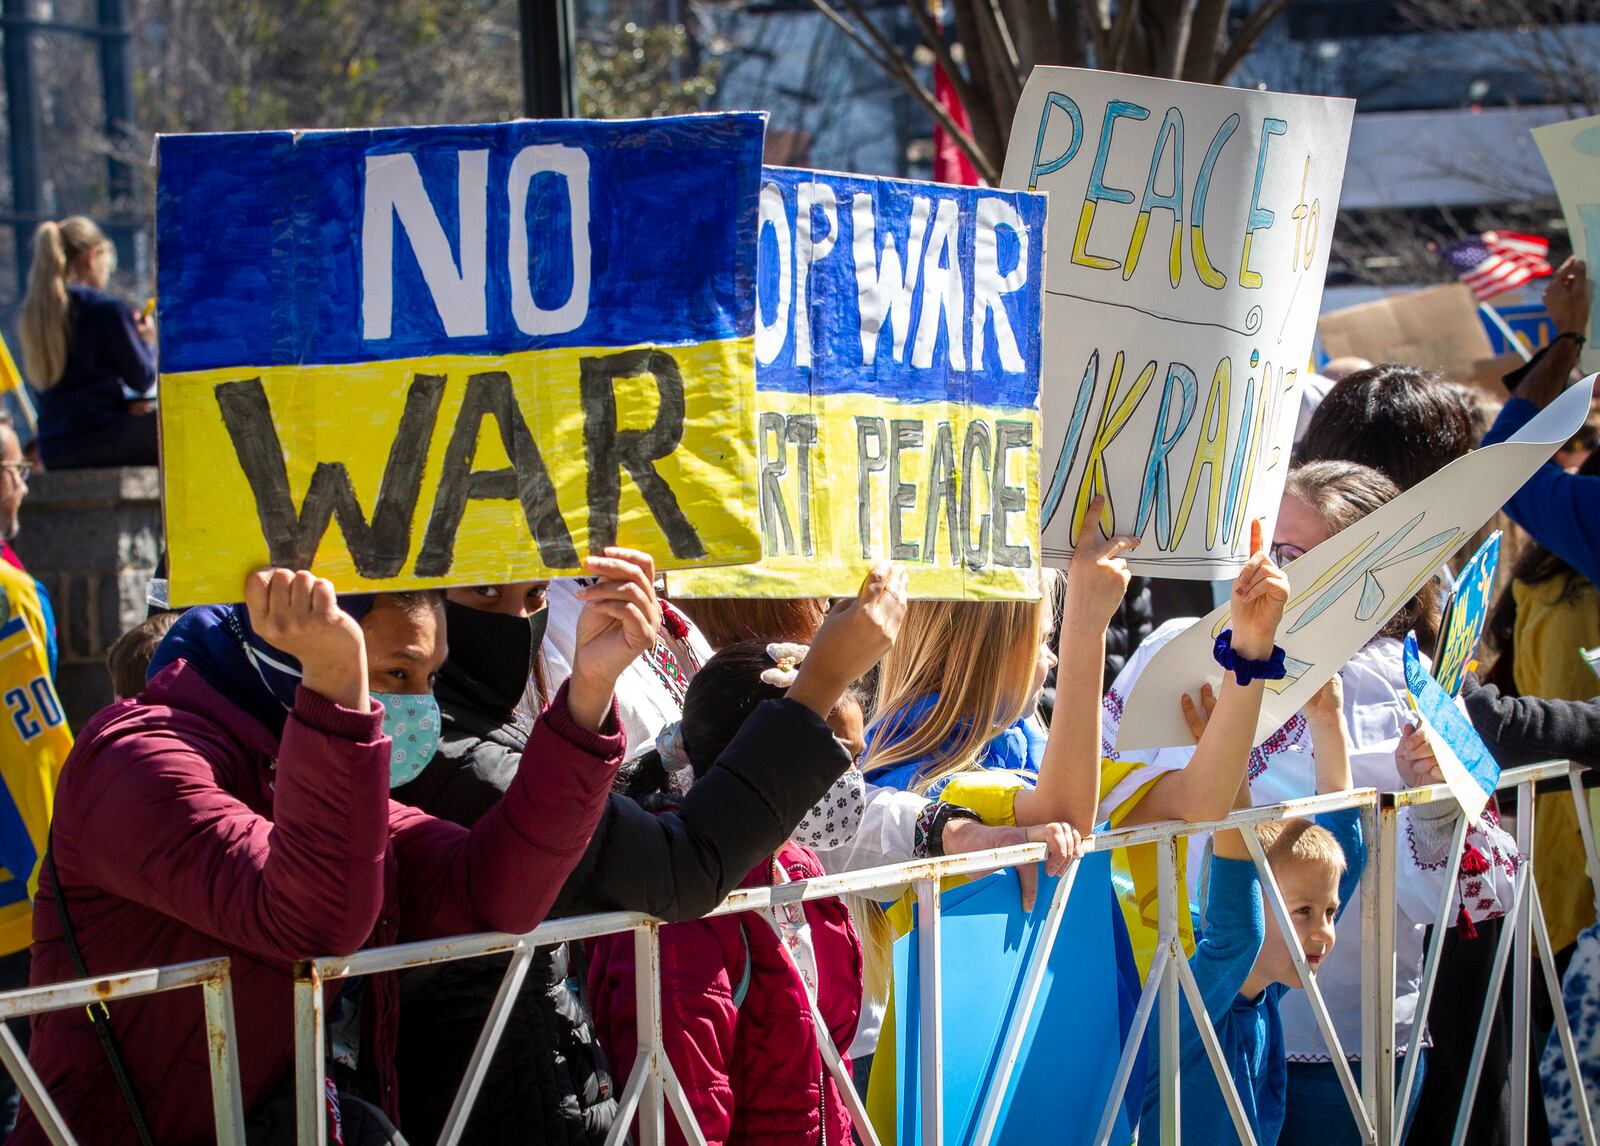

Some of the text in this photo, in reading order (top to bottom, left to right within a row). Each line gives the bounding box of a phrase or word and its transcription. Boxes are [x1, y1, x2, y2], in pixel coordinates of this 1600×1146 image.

[361, 142, 592, 340] NO
[852, 191, 1030, 373] WAR
[1028, 91, 1320, 289] PEACE to
[214, 347, 709, 579] WAR
[853, 415, 1033, 571] PEACE
[4, 675, 66, 743] 20
